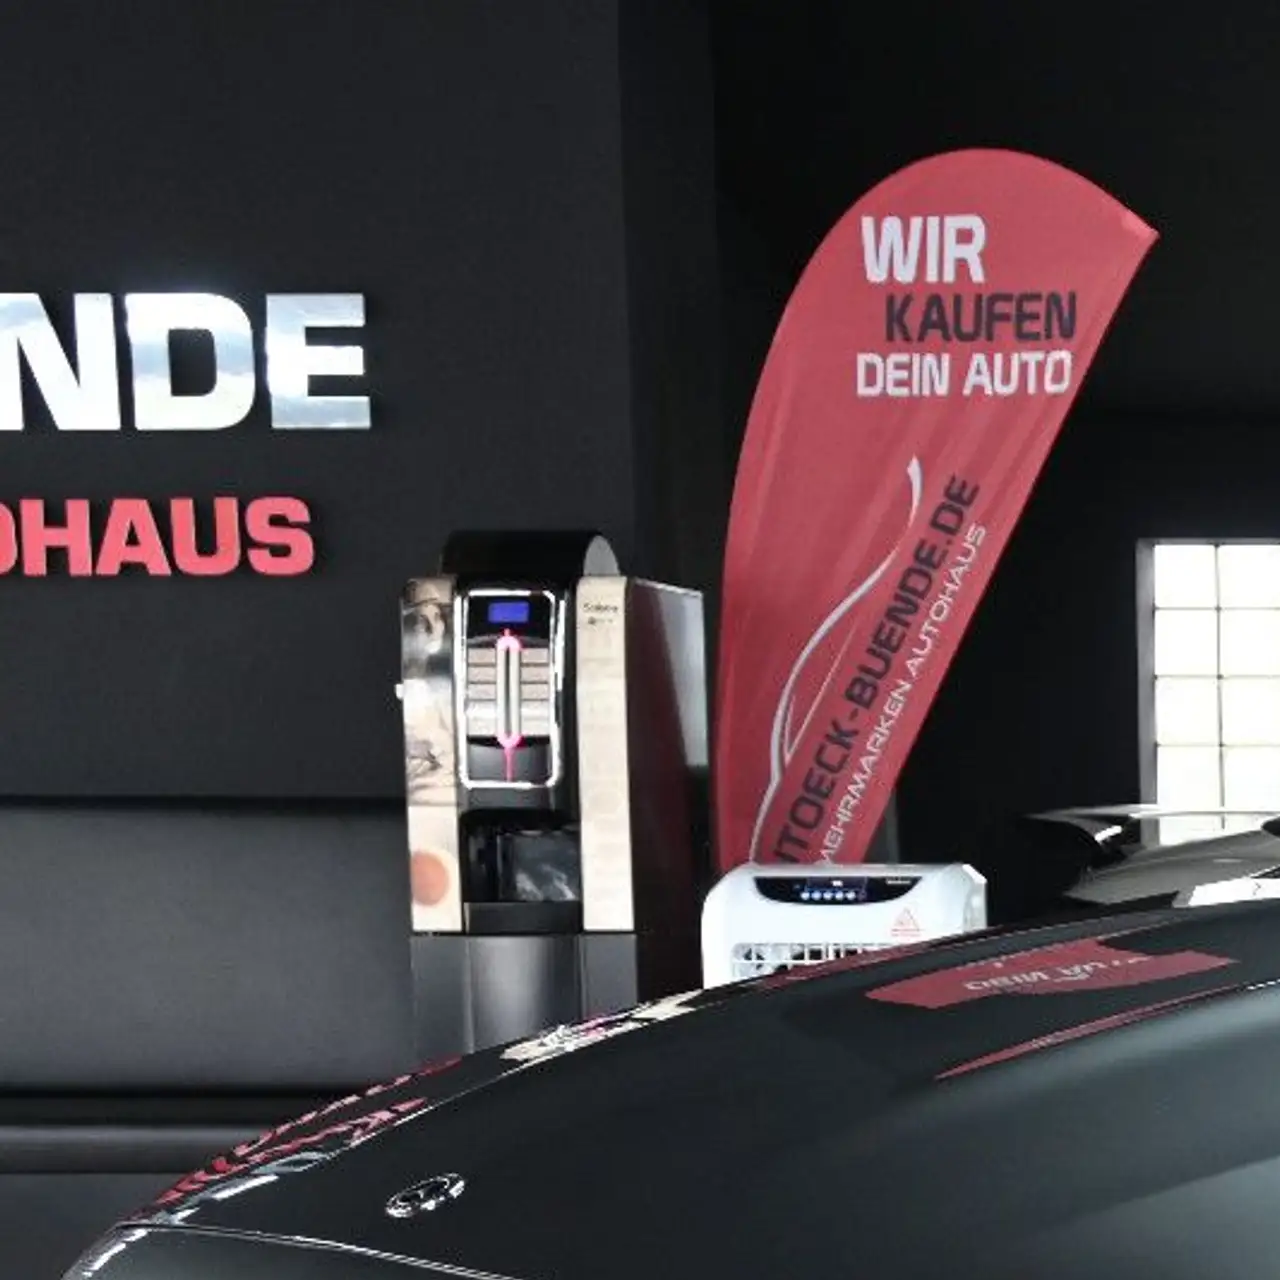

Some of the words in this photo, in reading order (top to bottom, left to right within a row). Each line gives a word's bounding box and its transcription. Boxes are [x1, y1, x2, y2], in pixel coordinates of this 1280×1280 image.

[861, 214, 986, 284] WIR
[885, 292, 1077, 343] KAUFEN
[856, 351, 950, 397] DEIN
[962, 348, 1073, 397] AUTO
[905, 522, 986, 678] AUTOHAUS
[774, 473, 980, 865] TOECK-BUENDE.DE
